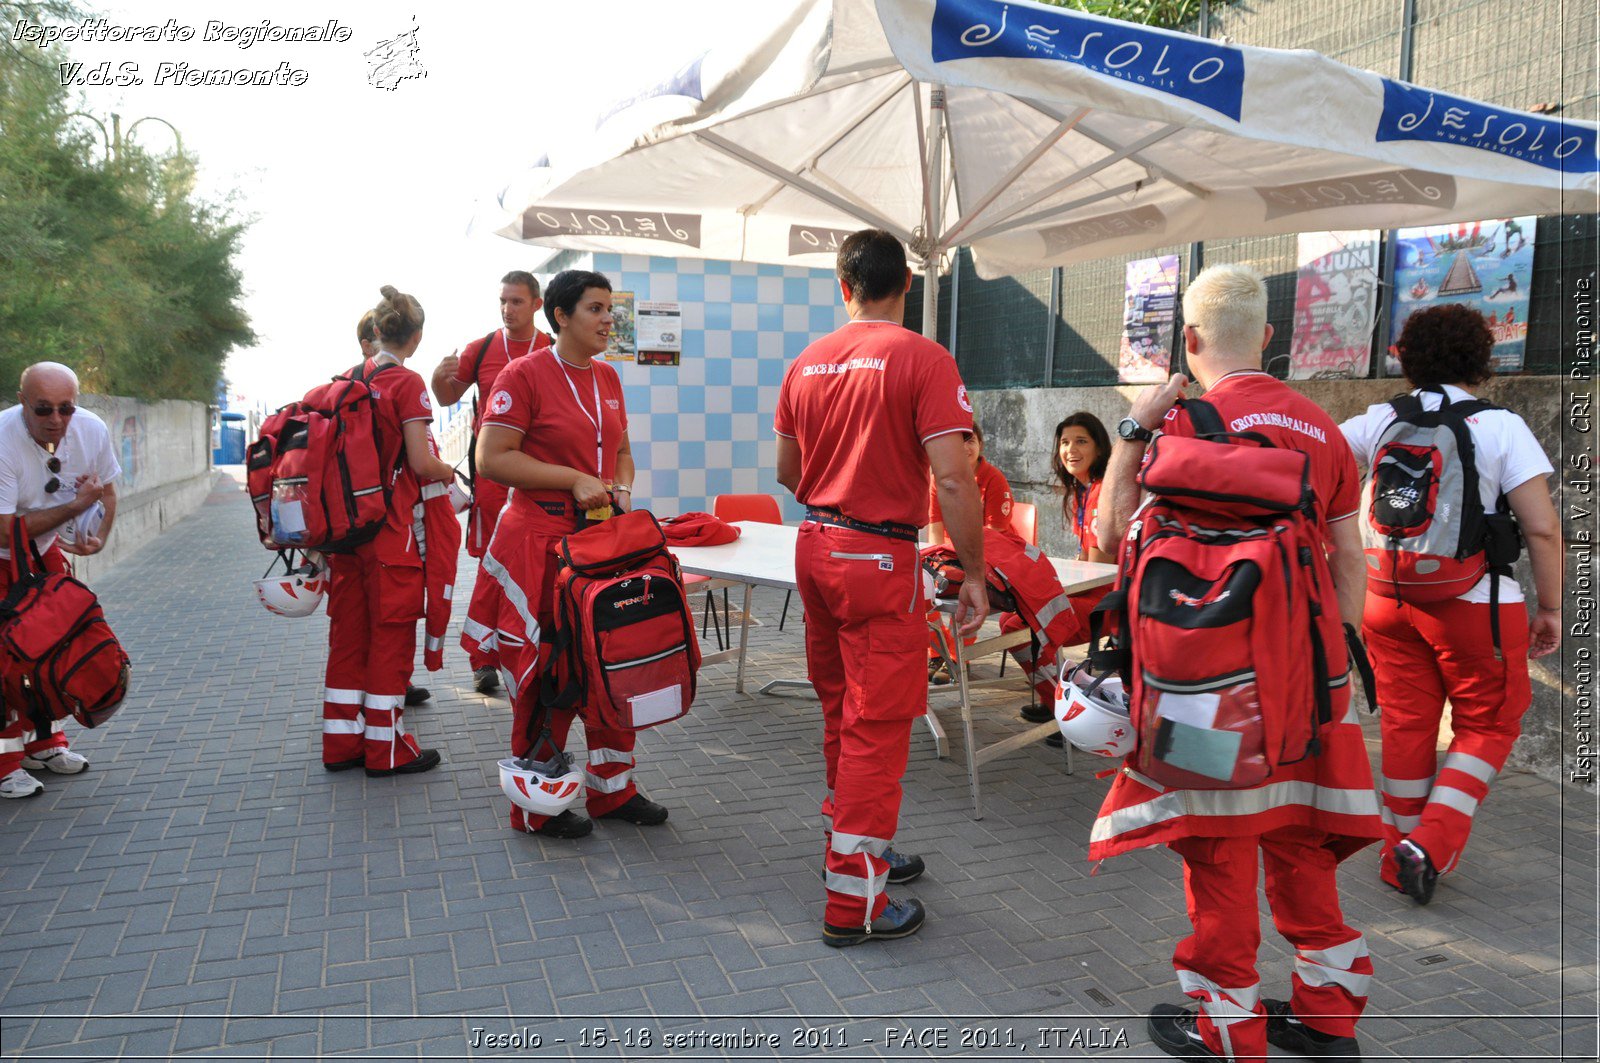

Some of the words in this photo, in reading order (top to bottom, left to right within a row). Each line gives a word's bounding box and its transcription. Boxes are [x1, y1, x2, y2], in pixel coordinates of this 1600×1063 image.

[960, 4, 1224, 84] JESOLO
[1397, 93, 1583, 159] JESOLO
[802, 364, 827, 377] CROCE
[1230, 413, 1261, 432] CROCE
[613, 592, 654, 610] SPENCR
